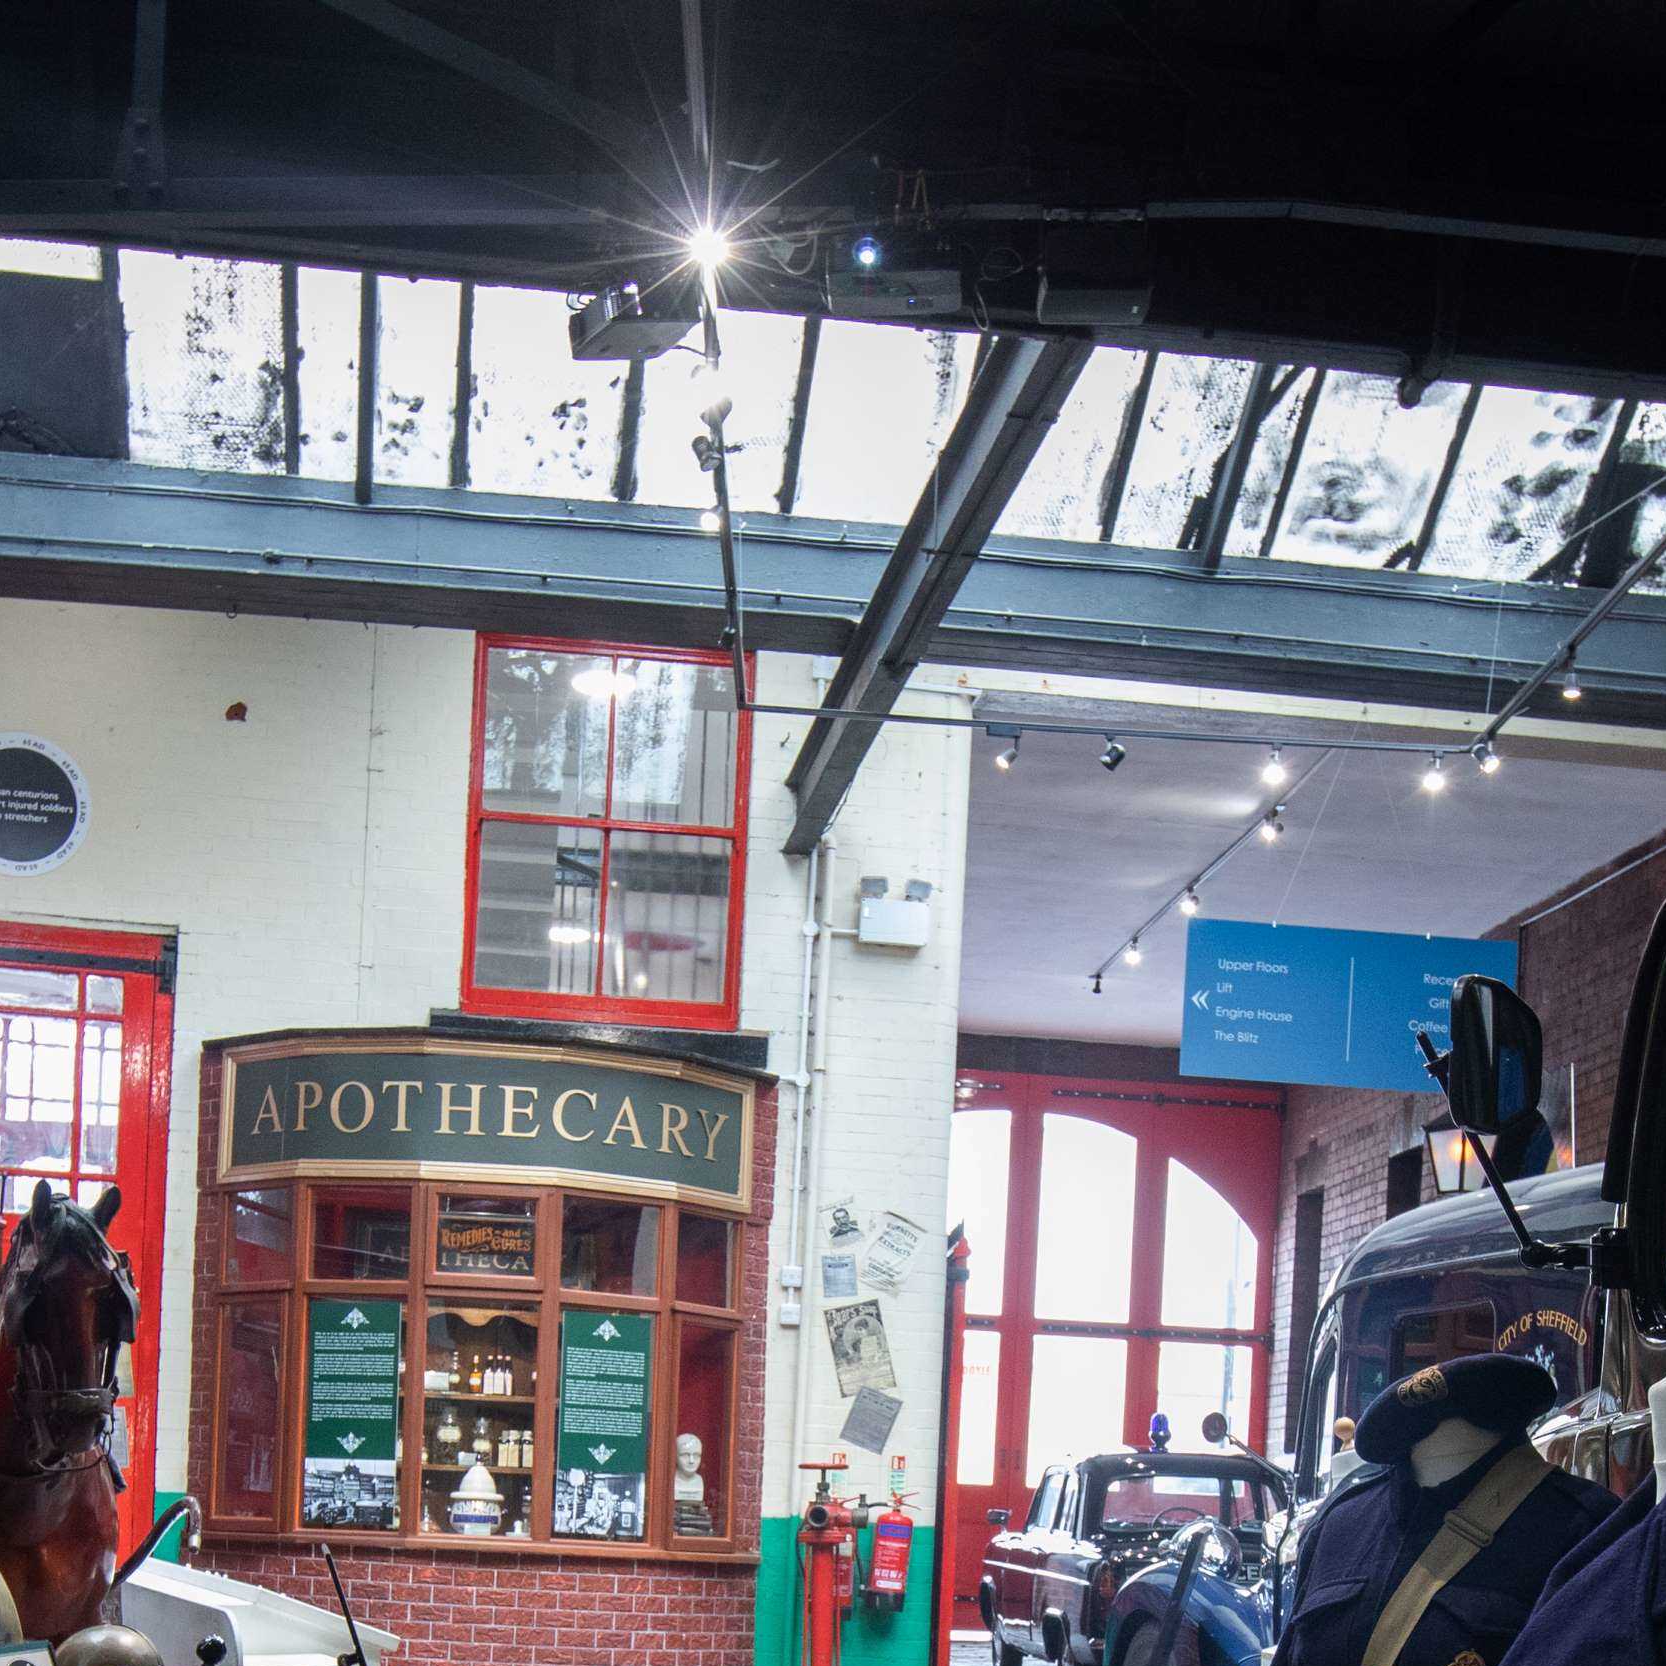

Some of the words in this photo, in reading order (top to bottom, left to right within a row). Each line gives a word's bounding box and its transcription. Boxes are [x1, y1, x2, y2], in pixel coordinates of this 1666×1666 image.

[13, 789, 59, 800] centurions
[8, 800, 37, 811] injured
[40, 803, 74, 813] soldiers
[5, 812, 48, 823] stretchers
[1217, 958, 1253, 972] Upper
[1256, 961, 1289, 974] Floors
[1216, 982, 1232, 993] Lift
[1215, 1006, 1254, 1020] Engine
[1257, 1009, 1292, 1022] House
[1408, 1020, 1448, 1033] Coffee
[1214, 1030, 1234, 1041] The
[1237, 1032, 1259, 1043] Blitz
[251, 1080, 730, 1162] APOTHECARY
[441, 1227, 493, 1250] REMEDIES
[502, 1229, 521, 1238] and
[492, 1238, 531, 1251] CURES
[1498, 1321, 1517, 1351] CITY
[1520, 1313, 1533, 1332] OF
[1536, 1310, 1587, 1346] SHEFFIELD
